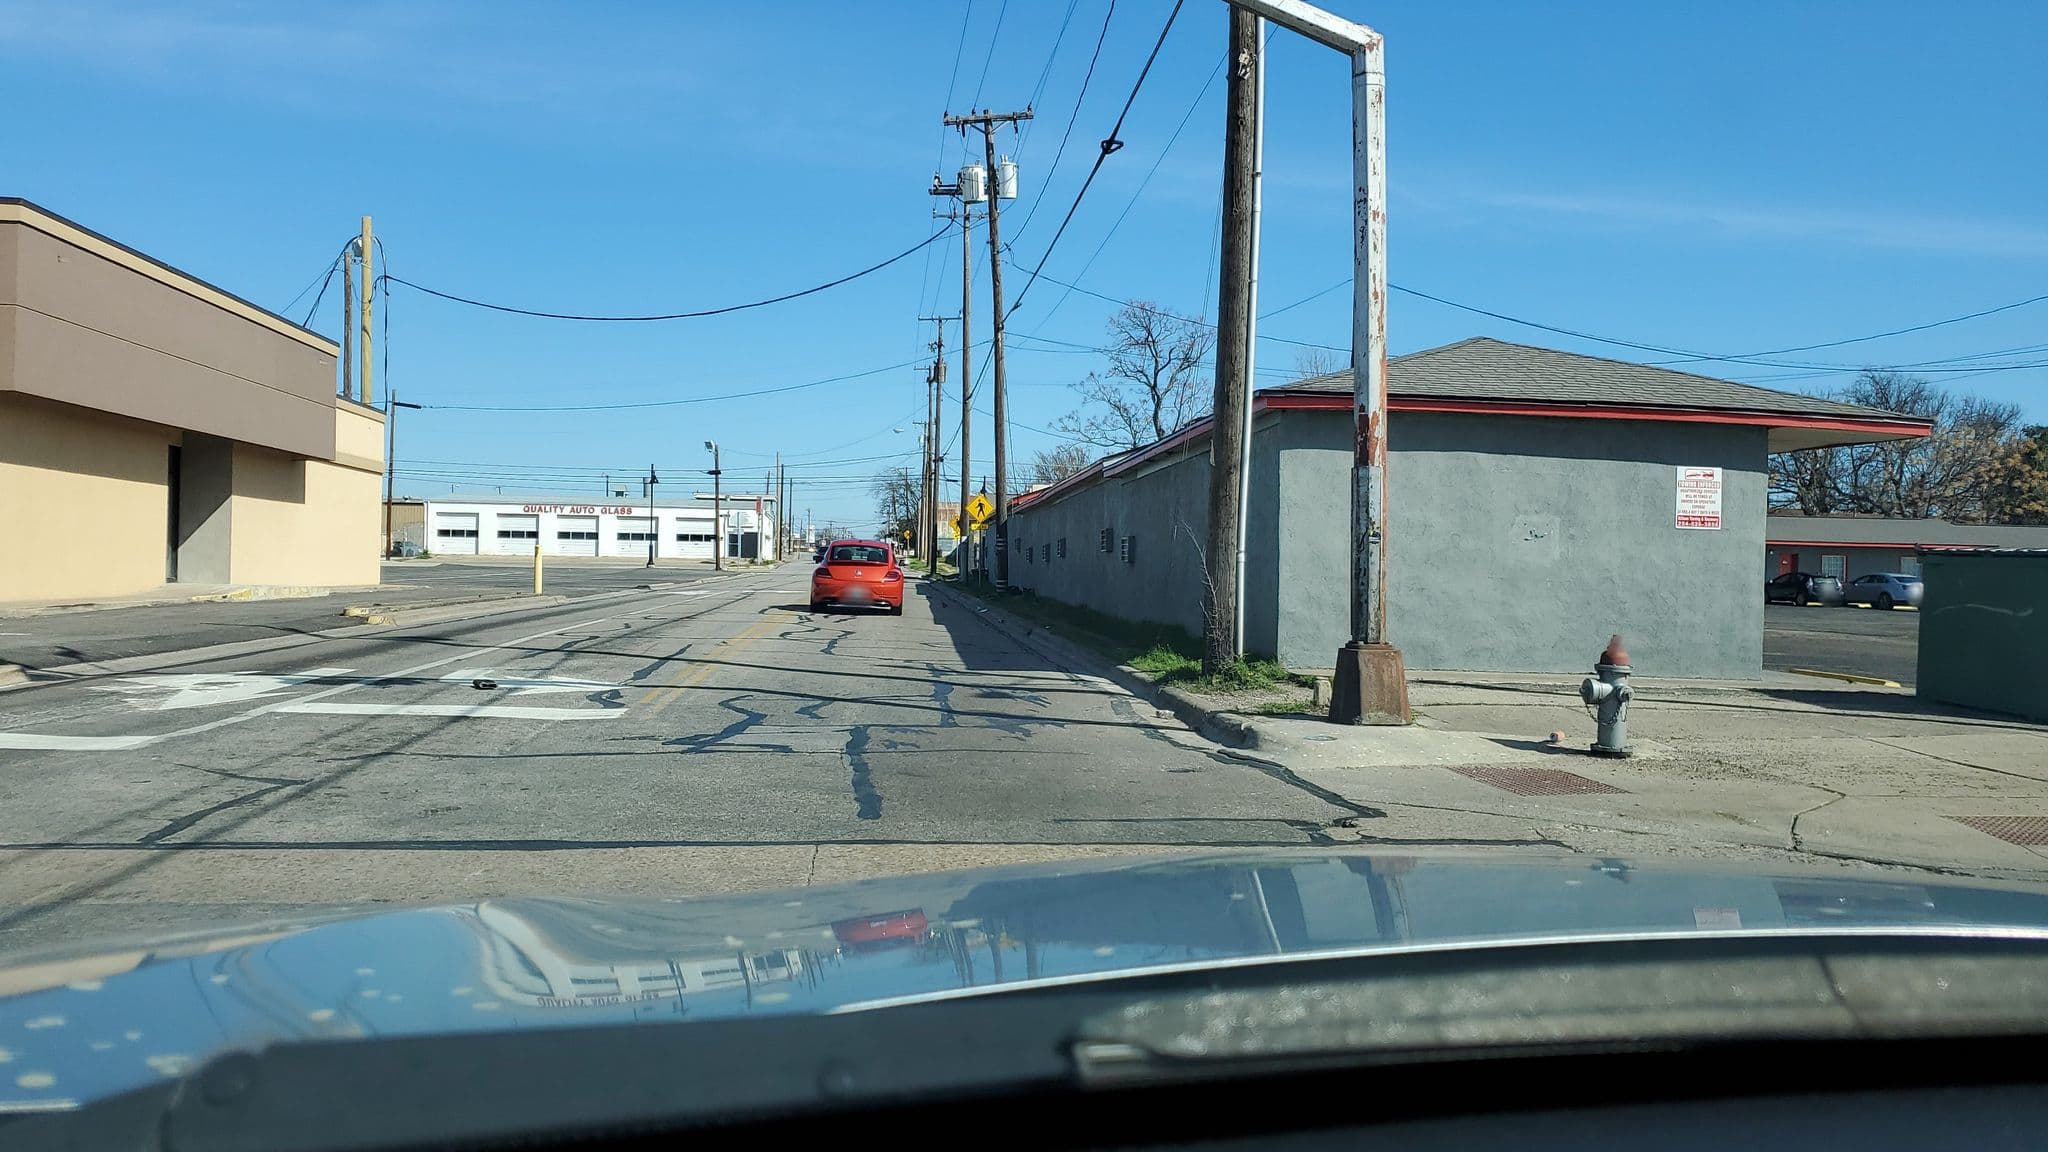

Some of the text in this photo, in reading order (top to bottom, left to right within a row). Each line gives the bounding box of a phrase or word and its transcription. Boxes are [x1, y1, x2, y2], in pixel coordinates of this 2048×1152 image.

[523, 505, 632, 515] QUALITY AUTO GLASS
